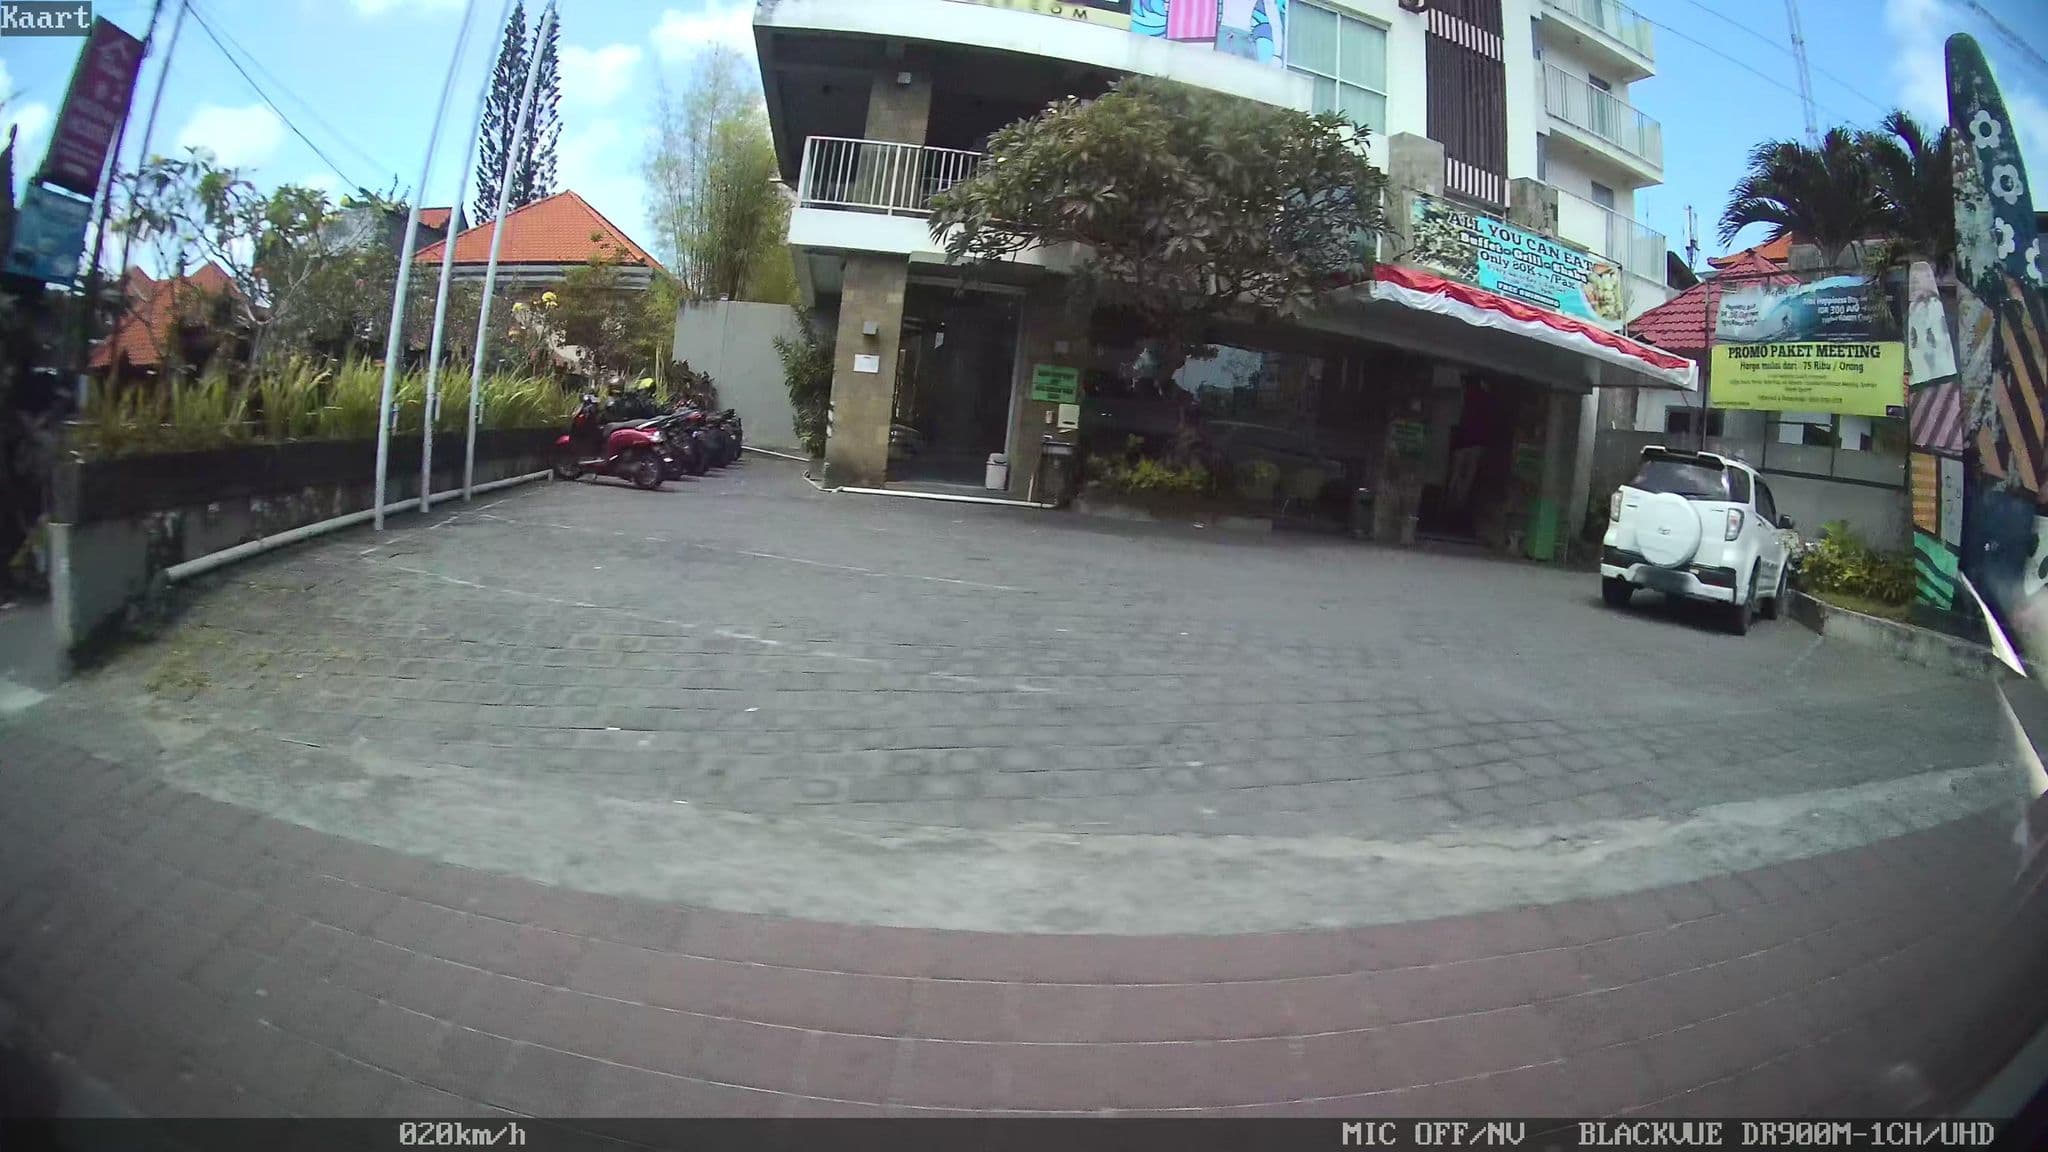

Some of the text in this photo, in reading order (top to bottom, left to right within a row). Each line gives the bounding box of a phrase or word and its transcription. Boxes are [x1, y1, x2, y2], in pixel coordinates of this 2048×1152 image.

[1448, 211, 1593, 272] ALL YOU CAN EAT
[1460, 231, 1503, 255] Buffet
[1512, 247, 1544, 268] Grill
[1551, 261, 1589, 284] Shabu
[1480, 250, 1510, 269] Only
[1728, 344, 1881, 359] PROMO PAKET MEETING
[1740, 362, 1760, 372] Harga
[1803, 361, 1812, 370] 75
[1814, 361, 1831, 370] Ribu
[1839, 361, 1864, 373] Orang
